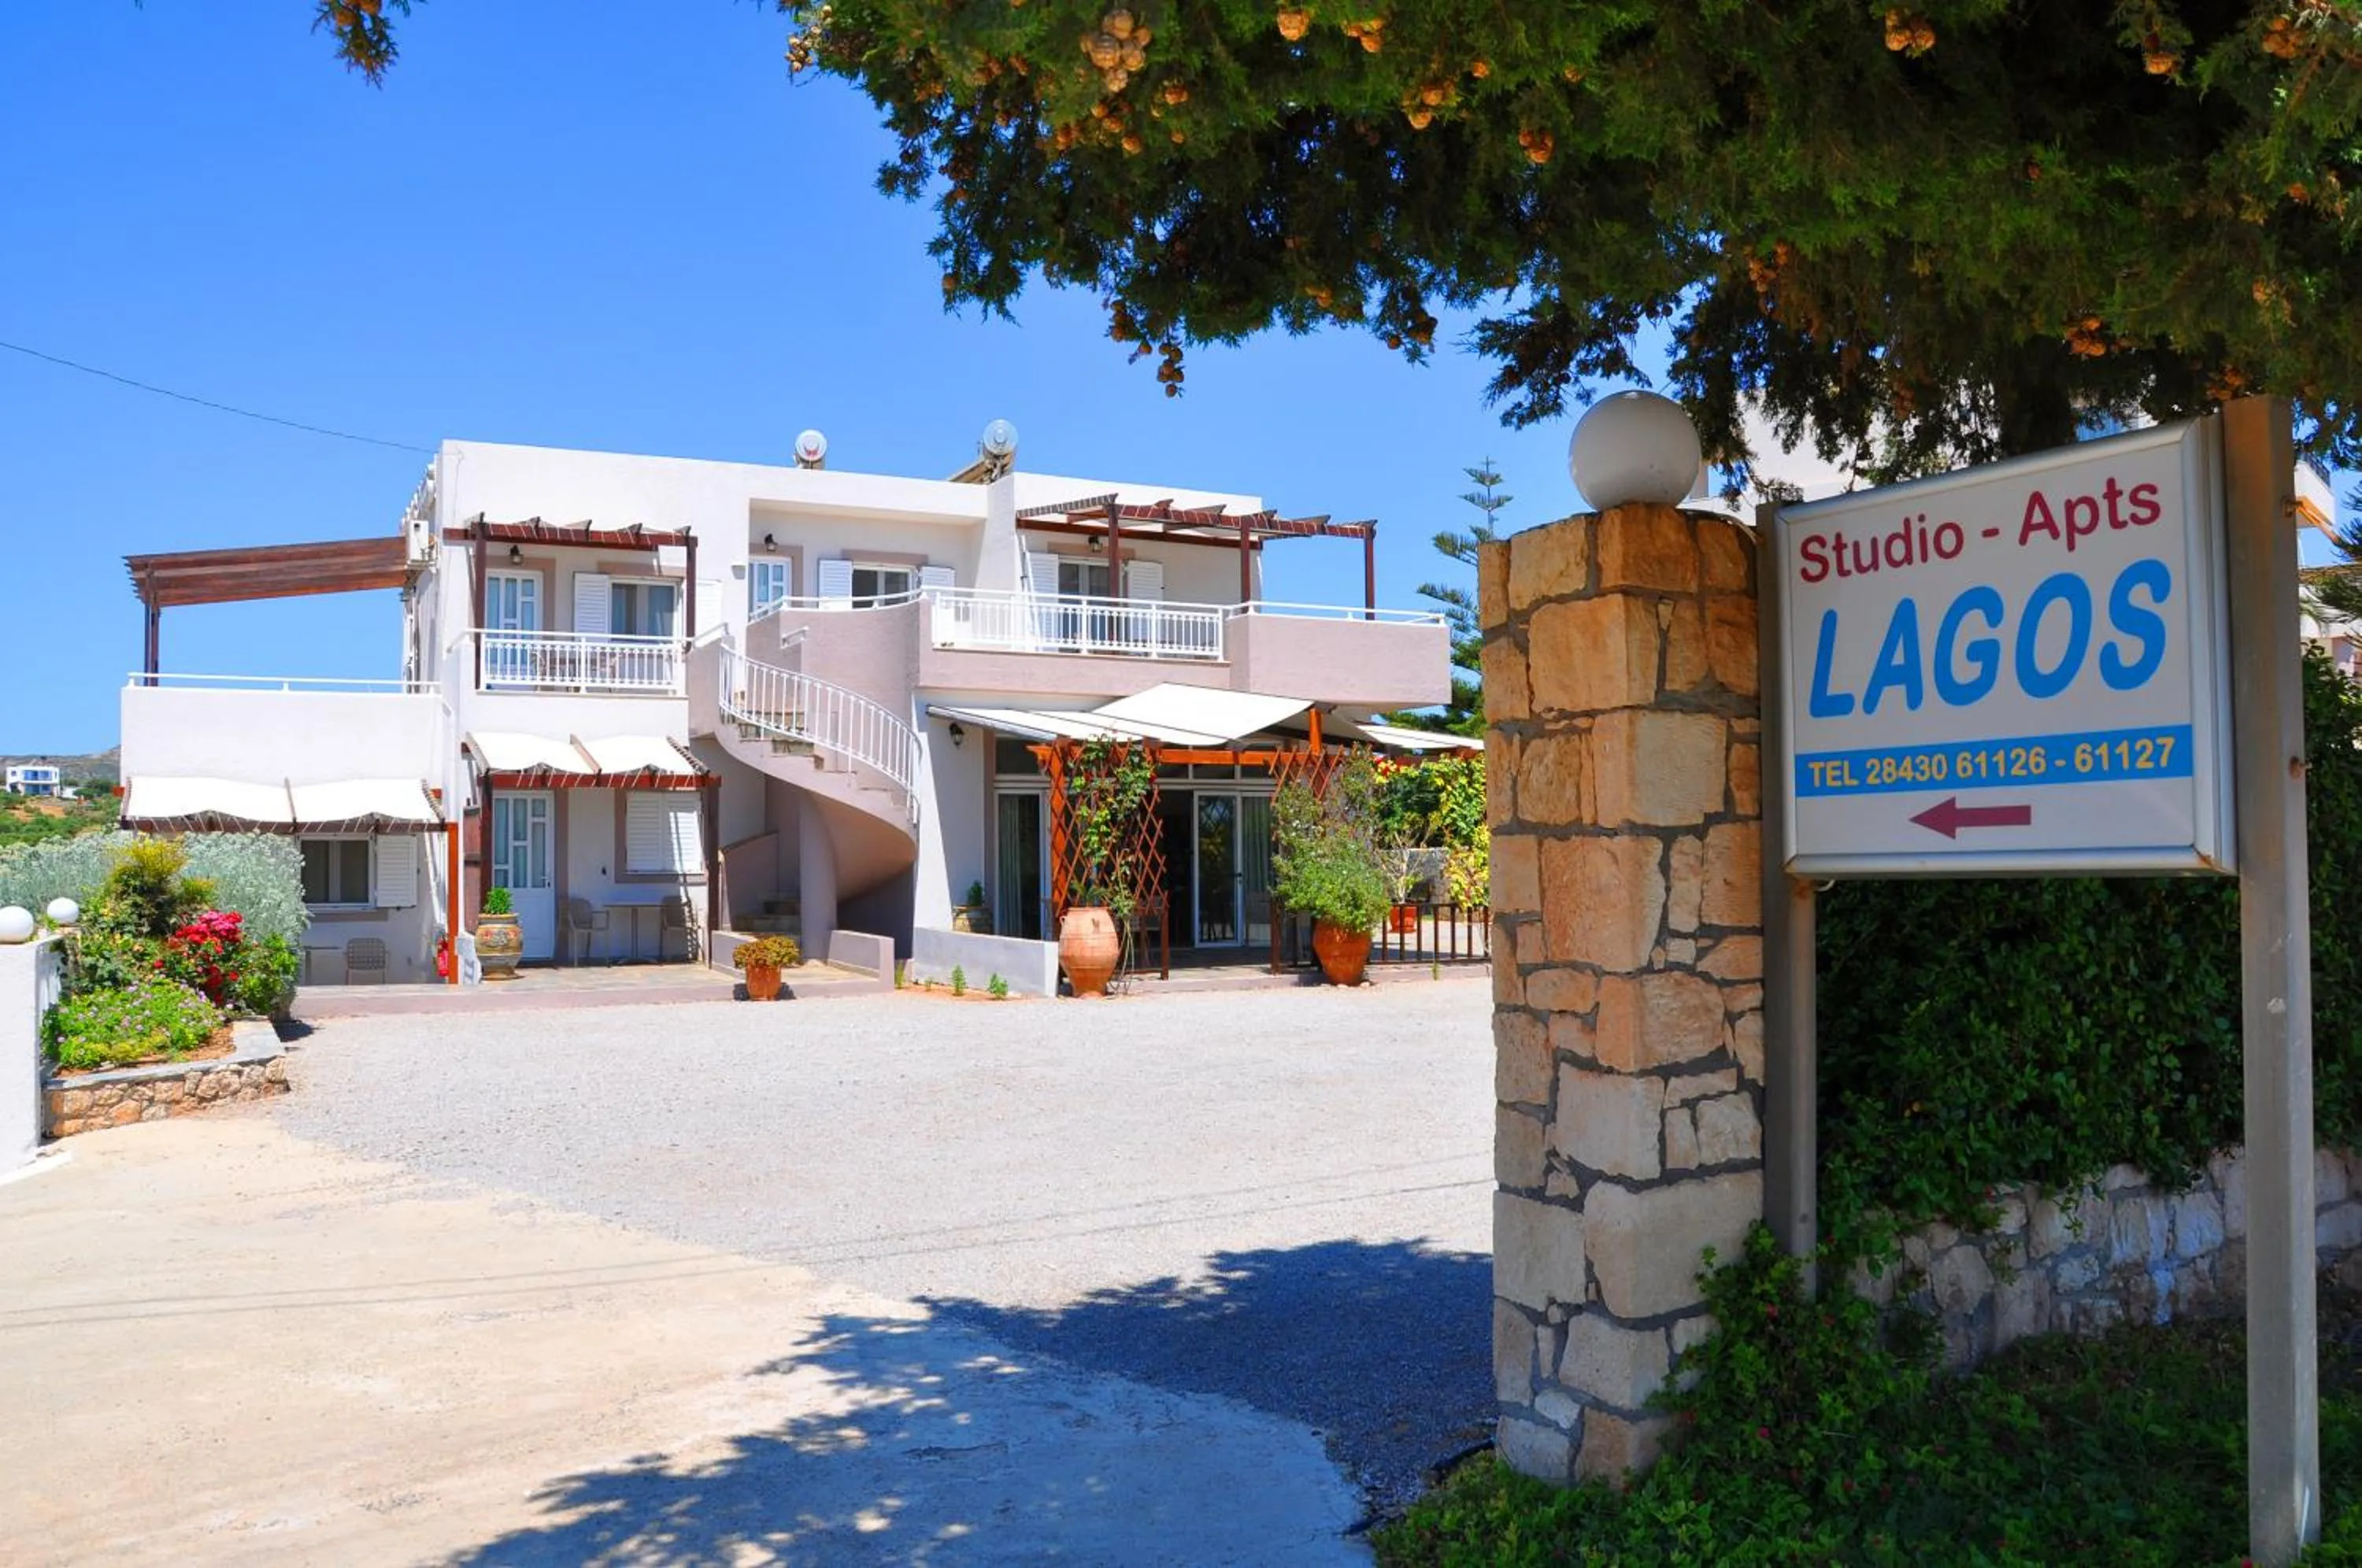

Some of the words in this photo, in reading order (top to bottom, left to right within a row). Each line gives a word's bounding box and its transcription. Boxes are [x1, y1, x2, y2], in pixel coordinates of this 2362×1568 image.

[1800, 513, 1965, 583] Studio
[1982, 527, 2001, 539] -
[2018, 477, 2162, 552] Apts
[1809, 558, 2172, 719] LAGOS
[1808, 760, 1859, 787] TEL
[1865, 753, 1948, 785] 28430
[1956, 746, 2047, 778] 61126
[2053, 759, 2068, 768] -
[2075, 737, 2176, 774] 61127
